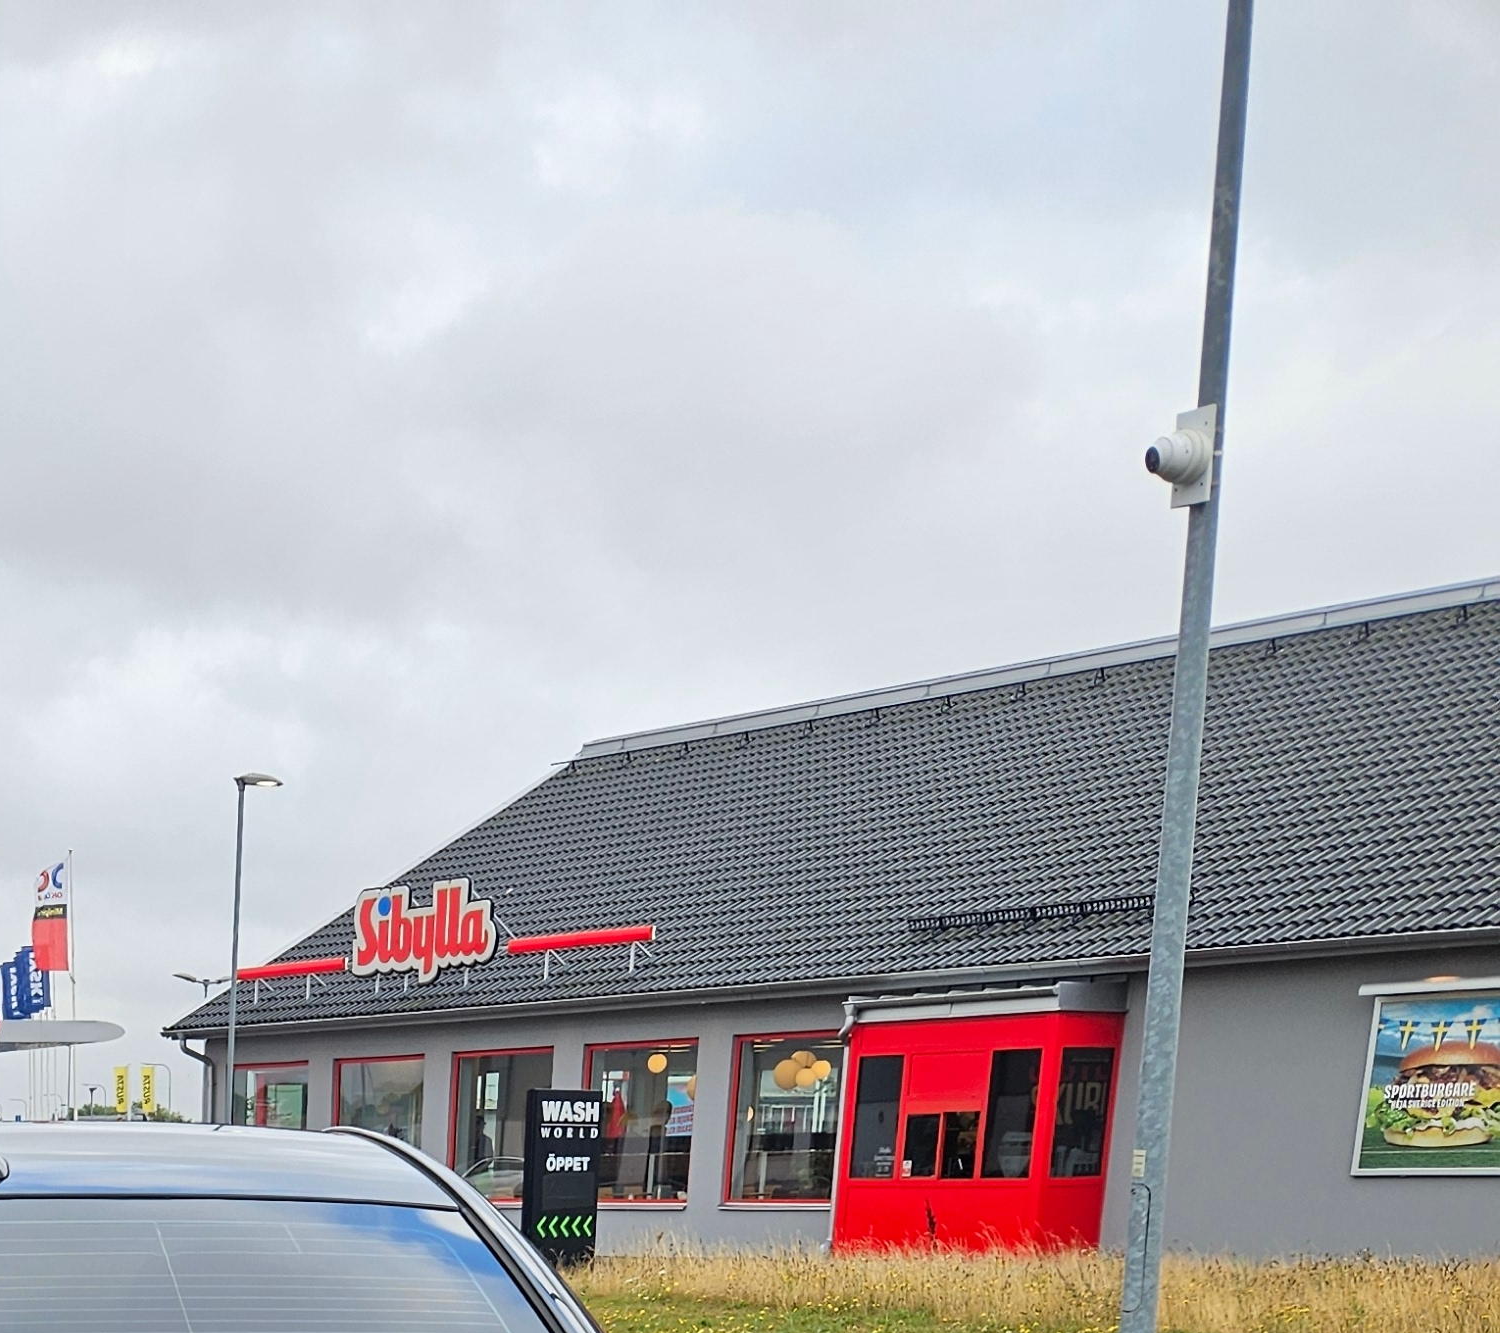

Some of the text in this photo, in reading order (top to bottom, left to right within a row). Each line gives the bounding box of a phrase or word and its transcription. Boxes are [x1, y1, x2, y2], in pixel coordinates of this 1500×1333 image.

[357, 886, 489, 975] Sibylla
[1383, 1081, 1477, 1099] SPORTBURGARE
[541, 1101, 600, 1123] WASH
[1408, 1099, 1436, 1109] SVERIGE
[541, 1127, 599, 1139] WORLD
[545, 1153, 591, 1172] ÖPPET
